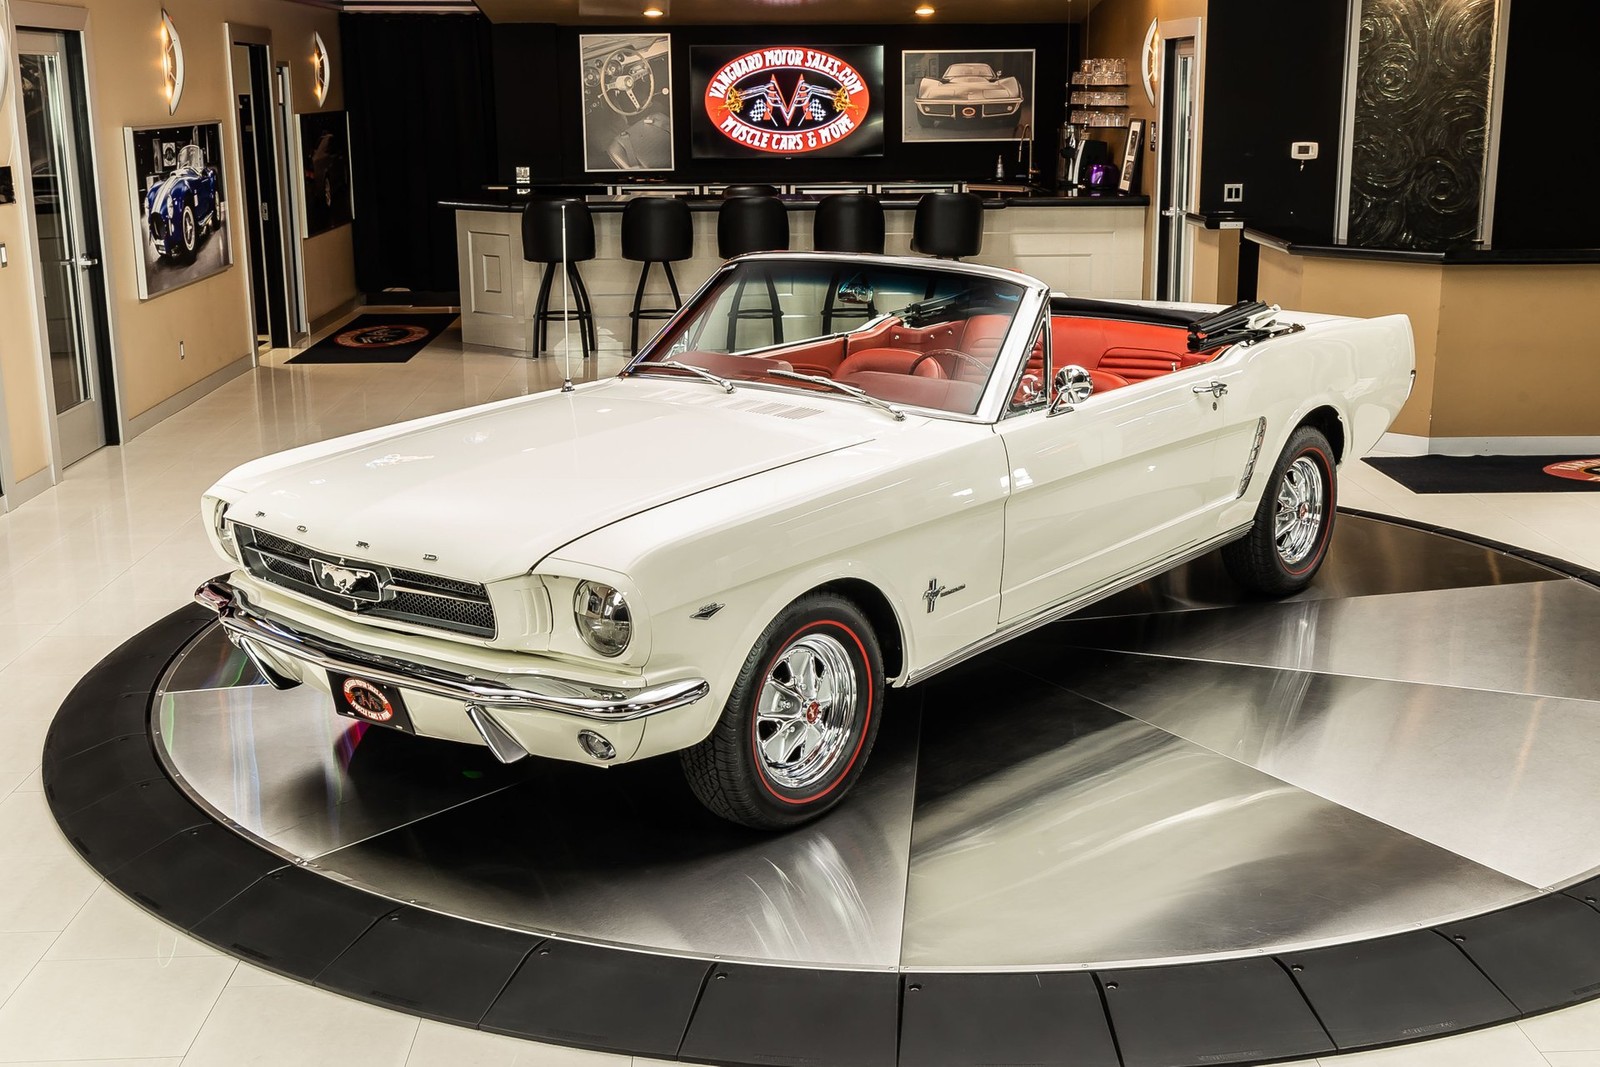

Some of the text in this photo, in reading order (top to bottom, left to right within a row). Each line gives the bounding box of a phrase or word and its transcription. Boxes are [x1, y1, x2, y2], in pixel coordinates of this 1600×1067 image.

[709, 49, 864, 98] VANGUARD MOTOR SALES.COM
[720, 114, 855, 150] MUSCLE CARS & MORE
